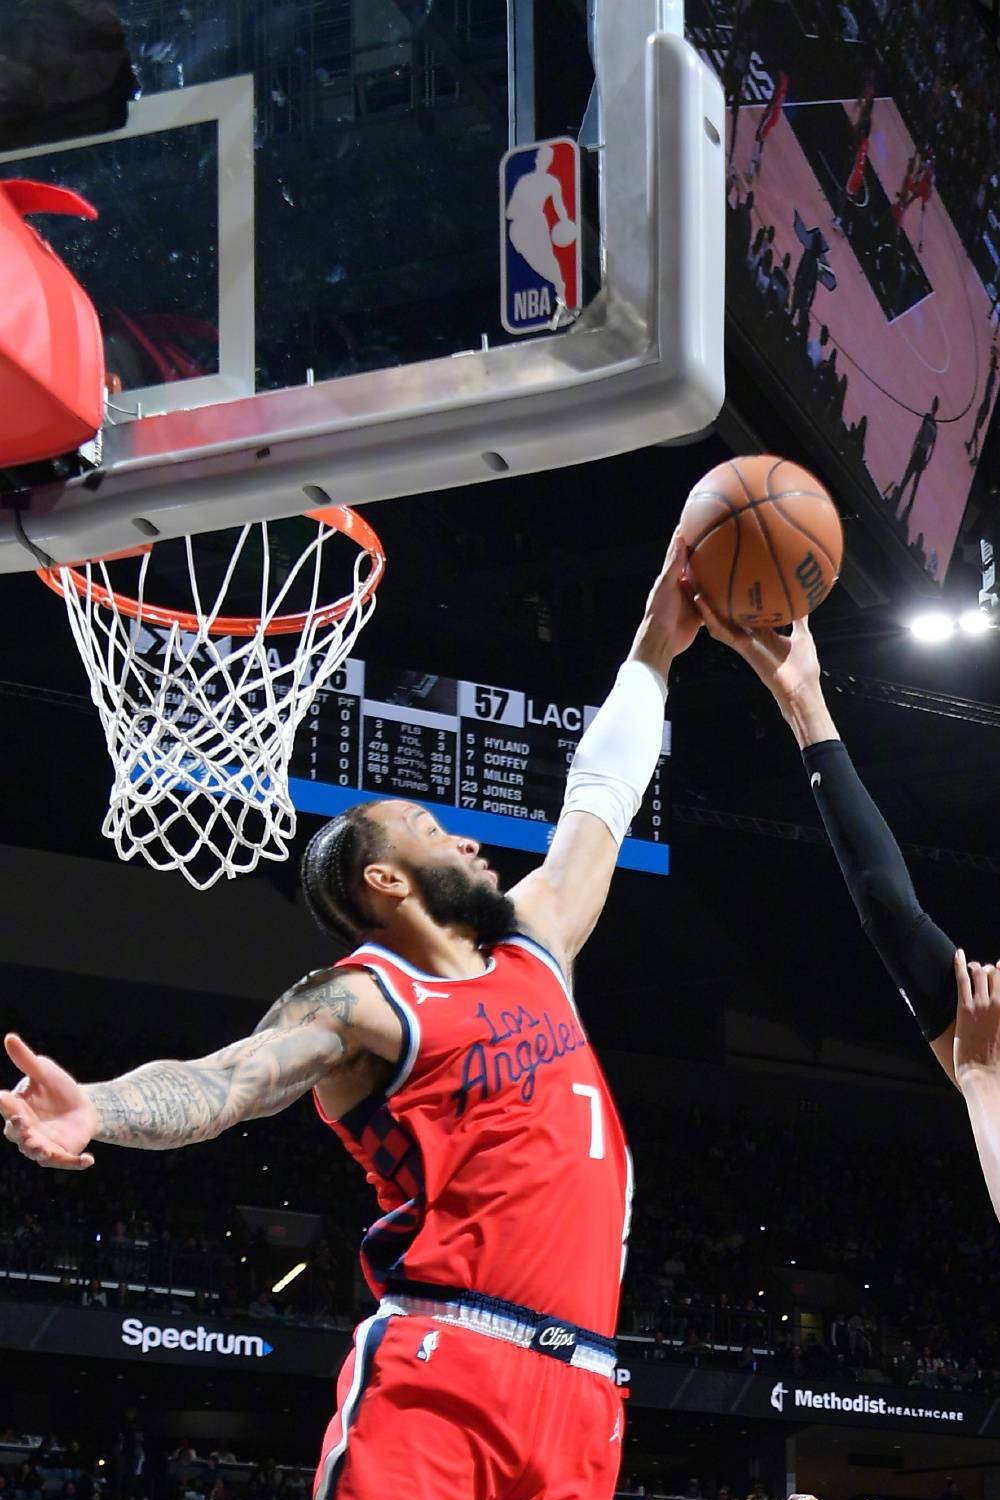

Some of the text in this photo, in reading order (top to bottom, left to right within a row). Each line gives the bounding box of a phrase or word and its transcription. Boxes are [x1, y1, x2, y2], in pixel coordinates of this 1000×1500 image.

[513, 286, 551, 321] NBA
[340, 709, 350, 721] 0
[475, 686, 582, 732] 57 LAC
[309, 720, 320, 732] 4
[340, 726, 350, 738] 3
[375, 719, 383, 729] 2
[437, 731, 446, 740] 2
[375, 730, 383, 740] 4
[310, 736, 317, 748] 1
[340, 742, 350, 754] 0
[465, 733, 475, 745] 5
[484, 736, 530, 756] HYLAND
[310, 752, 317, 764] 1
[339, 758, 350, 770] 0
[466, 749, 474, 761] 7
[484, 752, 528, 772] COFFEY
[310, 769, 349, 786] 1 0
[465, 765, 661, 812] 11 MILLER 0
[461, 780, 661, 827] 23 JONES 0
[461, 796, 477, 809] 77
[483, 799, 528, 819] PORTER
[476, 1001, 540, 1046] Los
[571, 1082, 605, 1160] 7
[121, 1317, 264, 1358] Spectrum
[538, 1326, 577, 1351] Clips
[794, 1388, 965, 1421] Methodist HEALTHCARE
